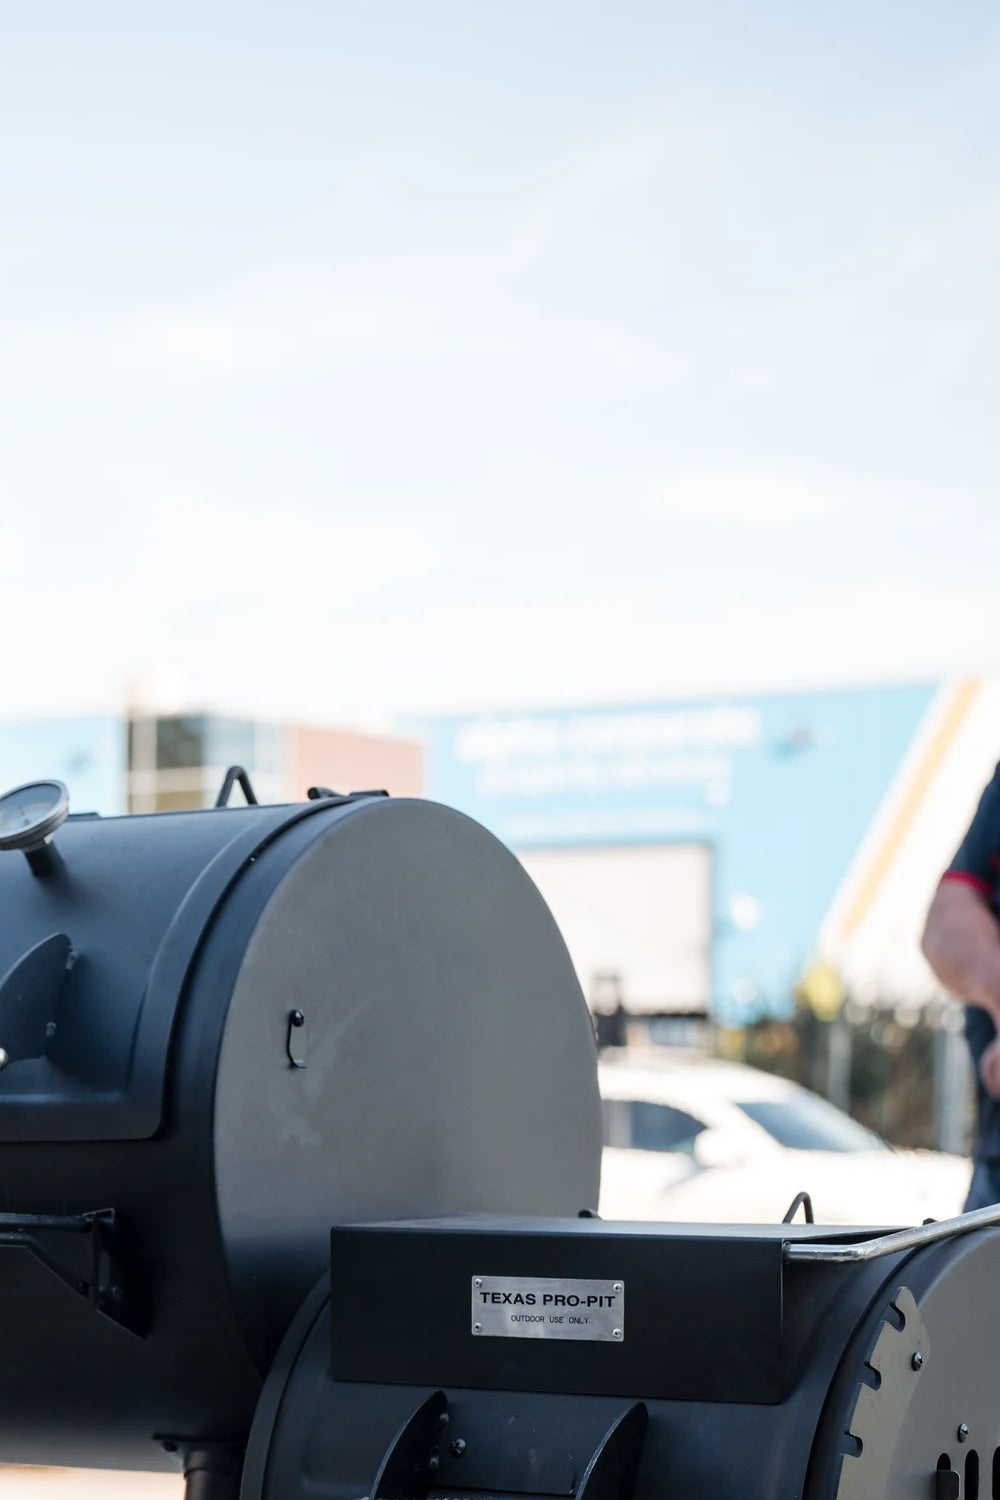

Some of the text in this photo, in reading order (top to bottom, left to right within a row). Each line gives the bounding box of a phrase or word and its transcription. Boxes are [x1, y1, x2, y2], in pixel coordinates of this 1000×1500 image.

[480, 1292, 616, 1308] TEXAS PRO-PIT
[511, 1314, 589, 1325] OUTDOOR USE ONLY
